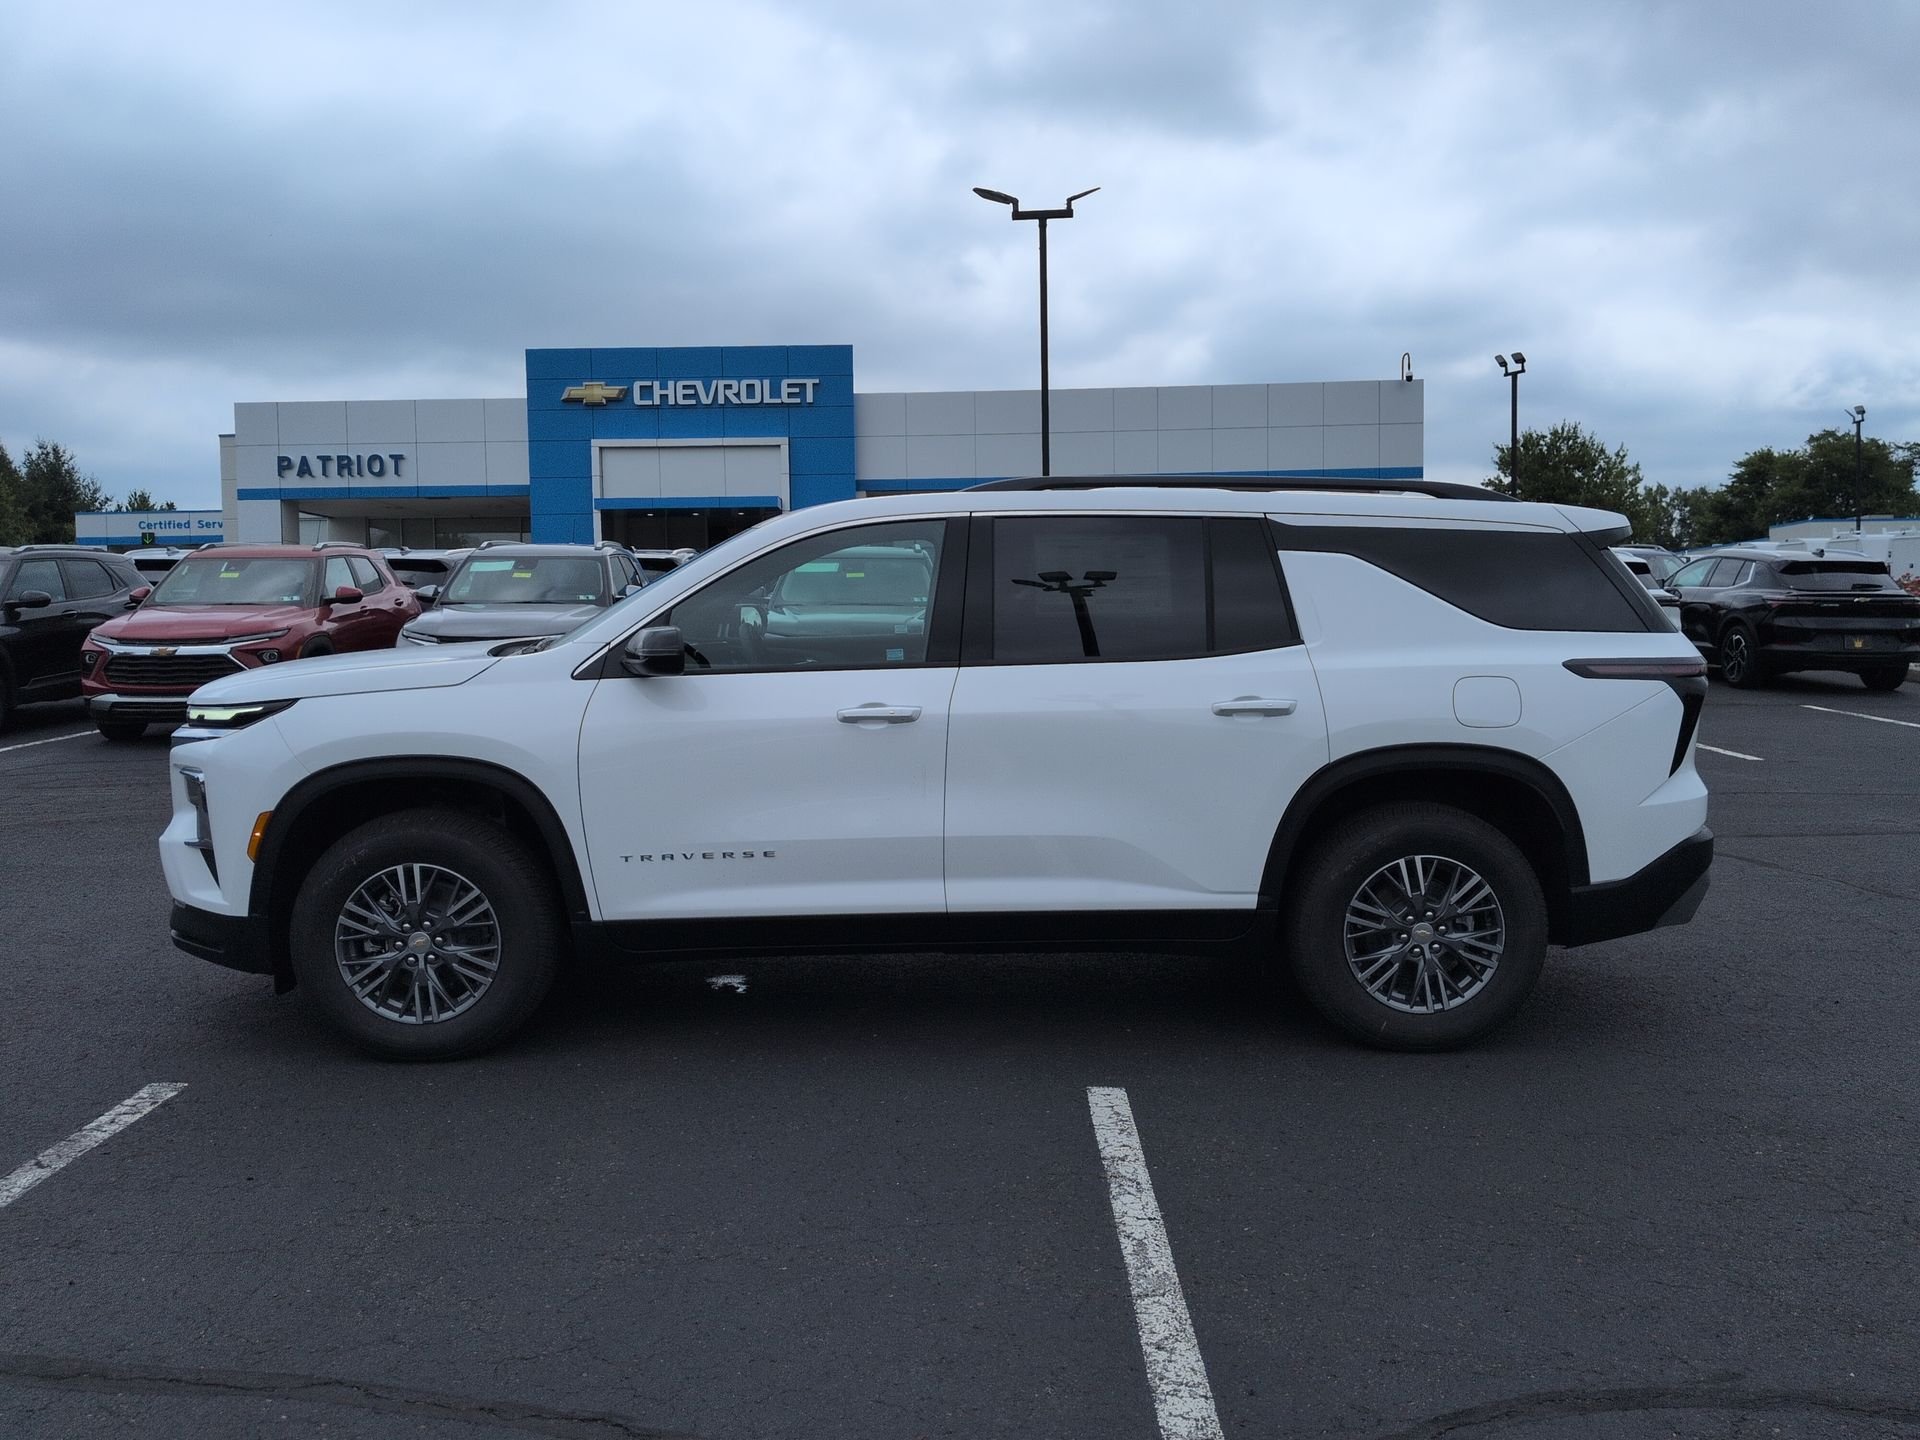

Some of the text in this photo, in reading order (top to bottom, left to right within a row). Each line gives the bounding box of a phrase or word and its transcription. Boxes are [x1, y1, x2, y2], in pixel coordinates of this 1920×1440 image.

[633, 378, 820, 406] CHEVROLET
[277, 454, 405, 478] PATRIOT
[138, 520, 191, 529] Certified
[619, 850, 777, 863] TRAVERSE
